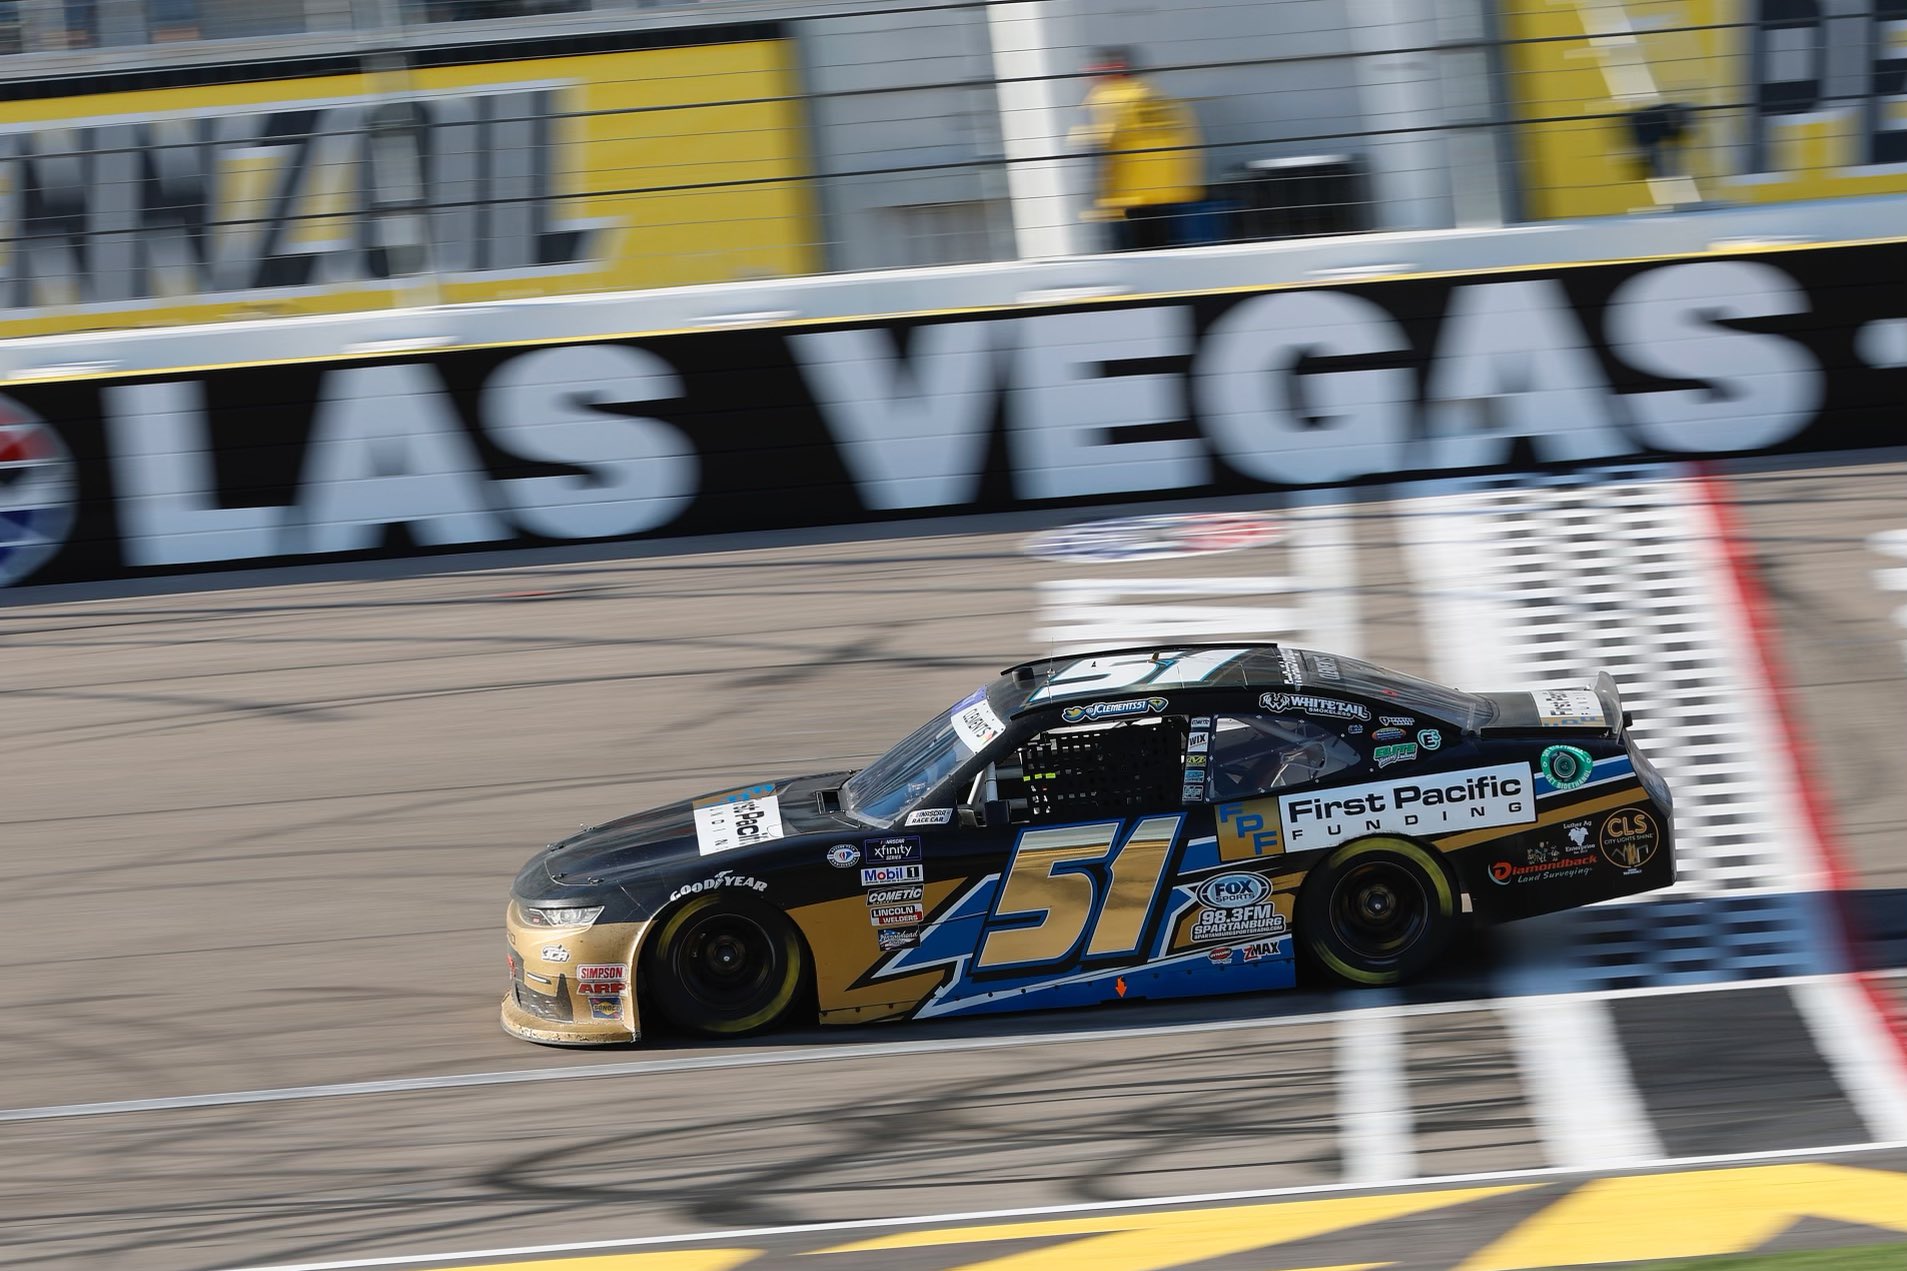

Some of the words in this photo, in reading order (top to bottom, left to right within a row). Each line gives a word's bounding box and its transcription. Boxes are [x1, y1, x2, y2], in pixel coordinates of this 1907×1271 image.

[102, 345, 700, 568] LAS
[783, 260, 1828, 512] VEGAS
[1029, 648, 1251, 702] 51
[1290, 696, 1368, 718] WHITETAIL
[1308, 707, 1351, 717] SMOKELESS
[1189, 733, 1206, 746] WIX
[1288, 793, 1386, 823] First
[1392, 775, 1522, 809] Pacific
[1292, 801, 1522, 841] FUNDING
[1607, 814, 1648, 837] CLS
[874, 844, 912, 858] xfinity
[864, 867, 903, 881] Mobil
[1493, 855, 1599, 880] Diamondback
[1518, 874, 1540, 883] Land
[1543, 868, 1590, 881] Surveying
[868, 887, 922, 903] COMETIC
[974, 813, 1186, 971] 51
[1214, 880, 1254, 896] FOX
[1215, 893, 1255, 902] SPORTS
[873, 906, 914, 917] LINCOLN
[883, 914, 918, 923] WELDERS
[1194, 917, 1282, 935] SPARTANBURG
[581, 967, 622, 979] SIMPSON
[578, 983, 626, 994] ARP
